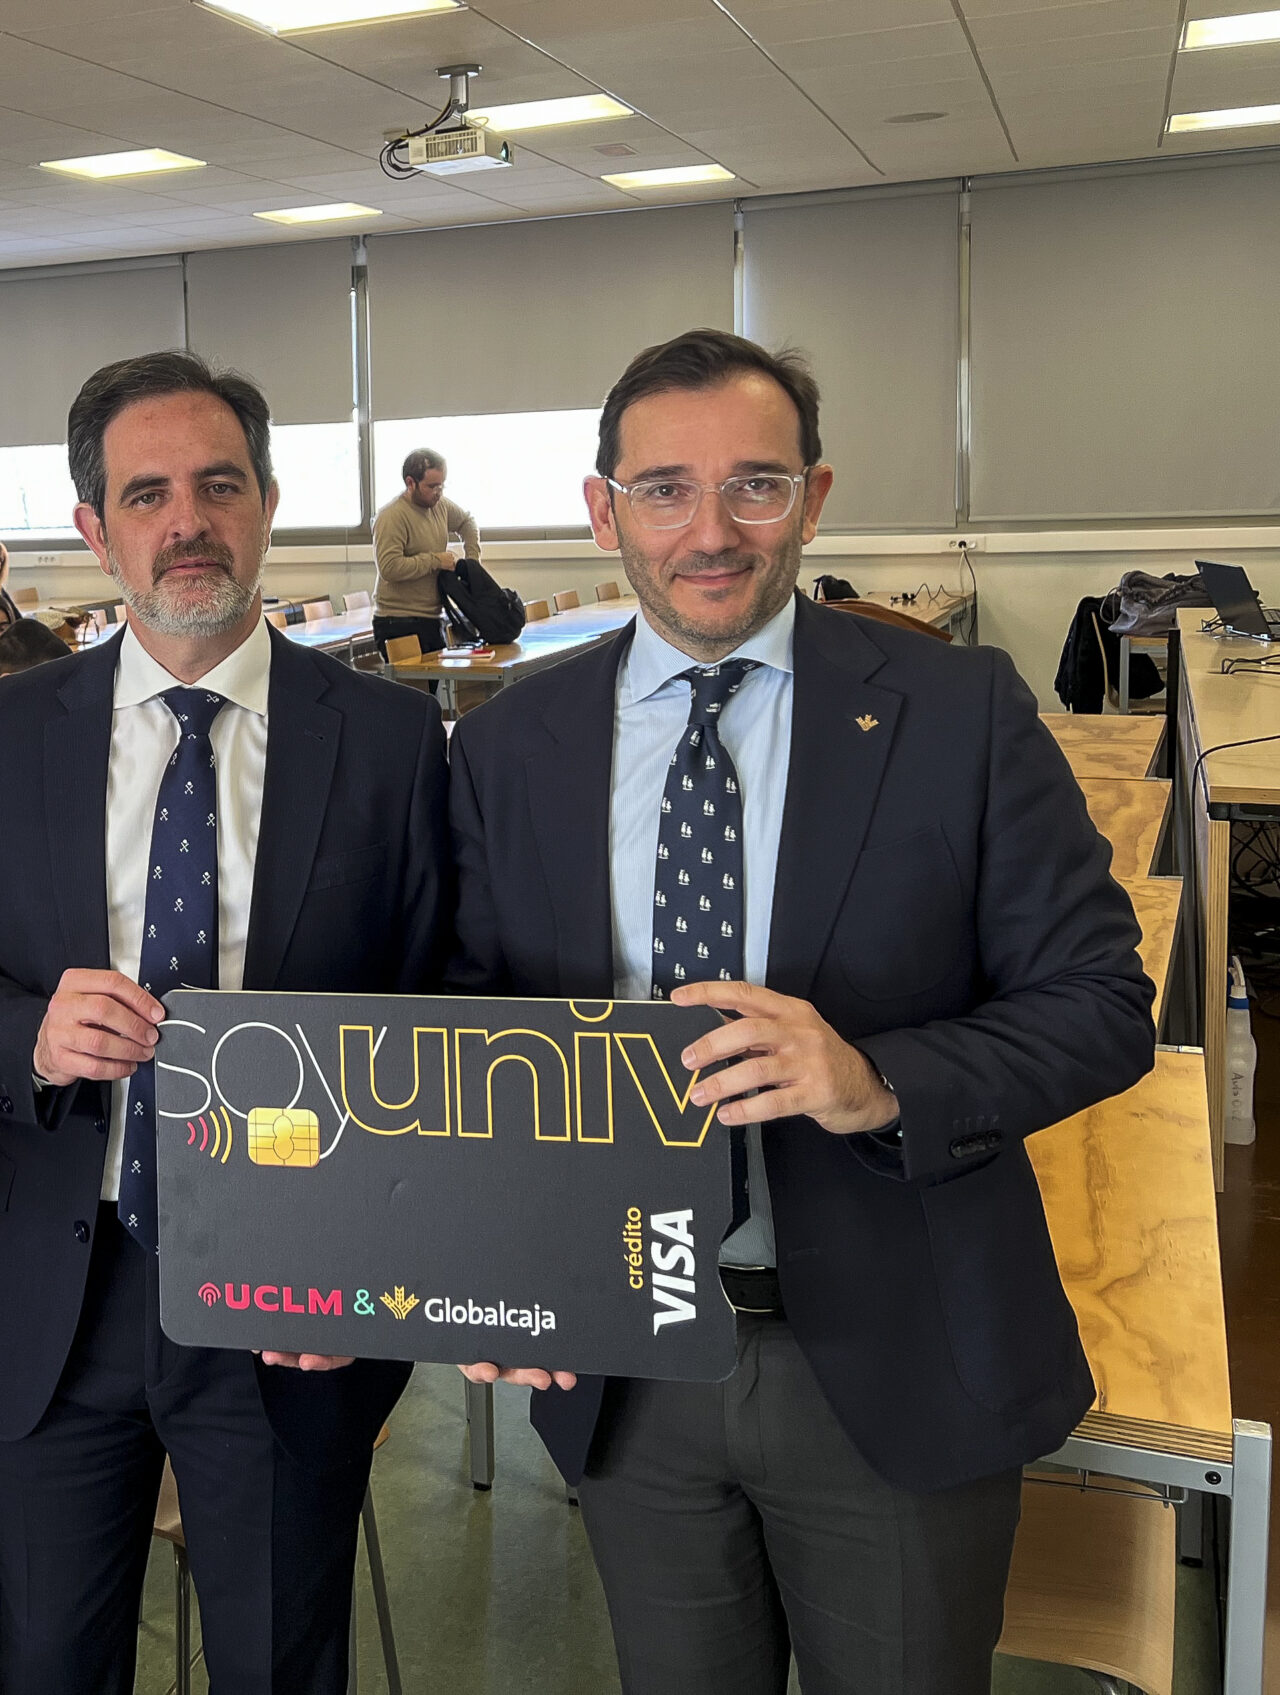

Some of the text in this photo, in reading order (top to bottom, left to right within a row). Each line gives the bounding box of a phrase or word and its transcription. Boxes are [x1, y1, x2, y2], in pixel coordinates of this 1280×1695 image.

[624, 1207, 644, 1290] crédito
[649, 1208, 697, 1336] VISA
[224, 1282, 556, 1337] UCLM & Globalcaja
